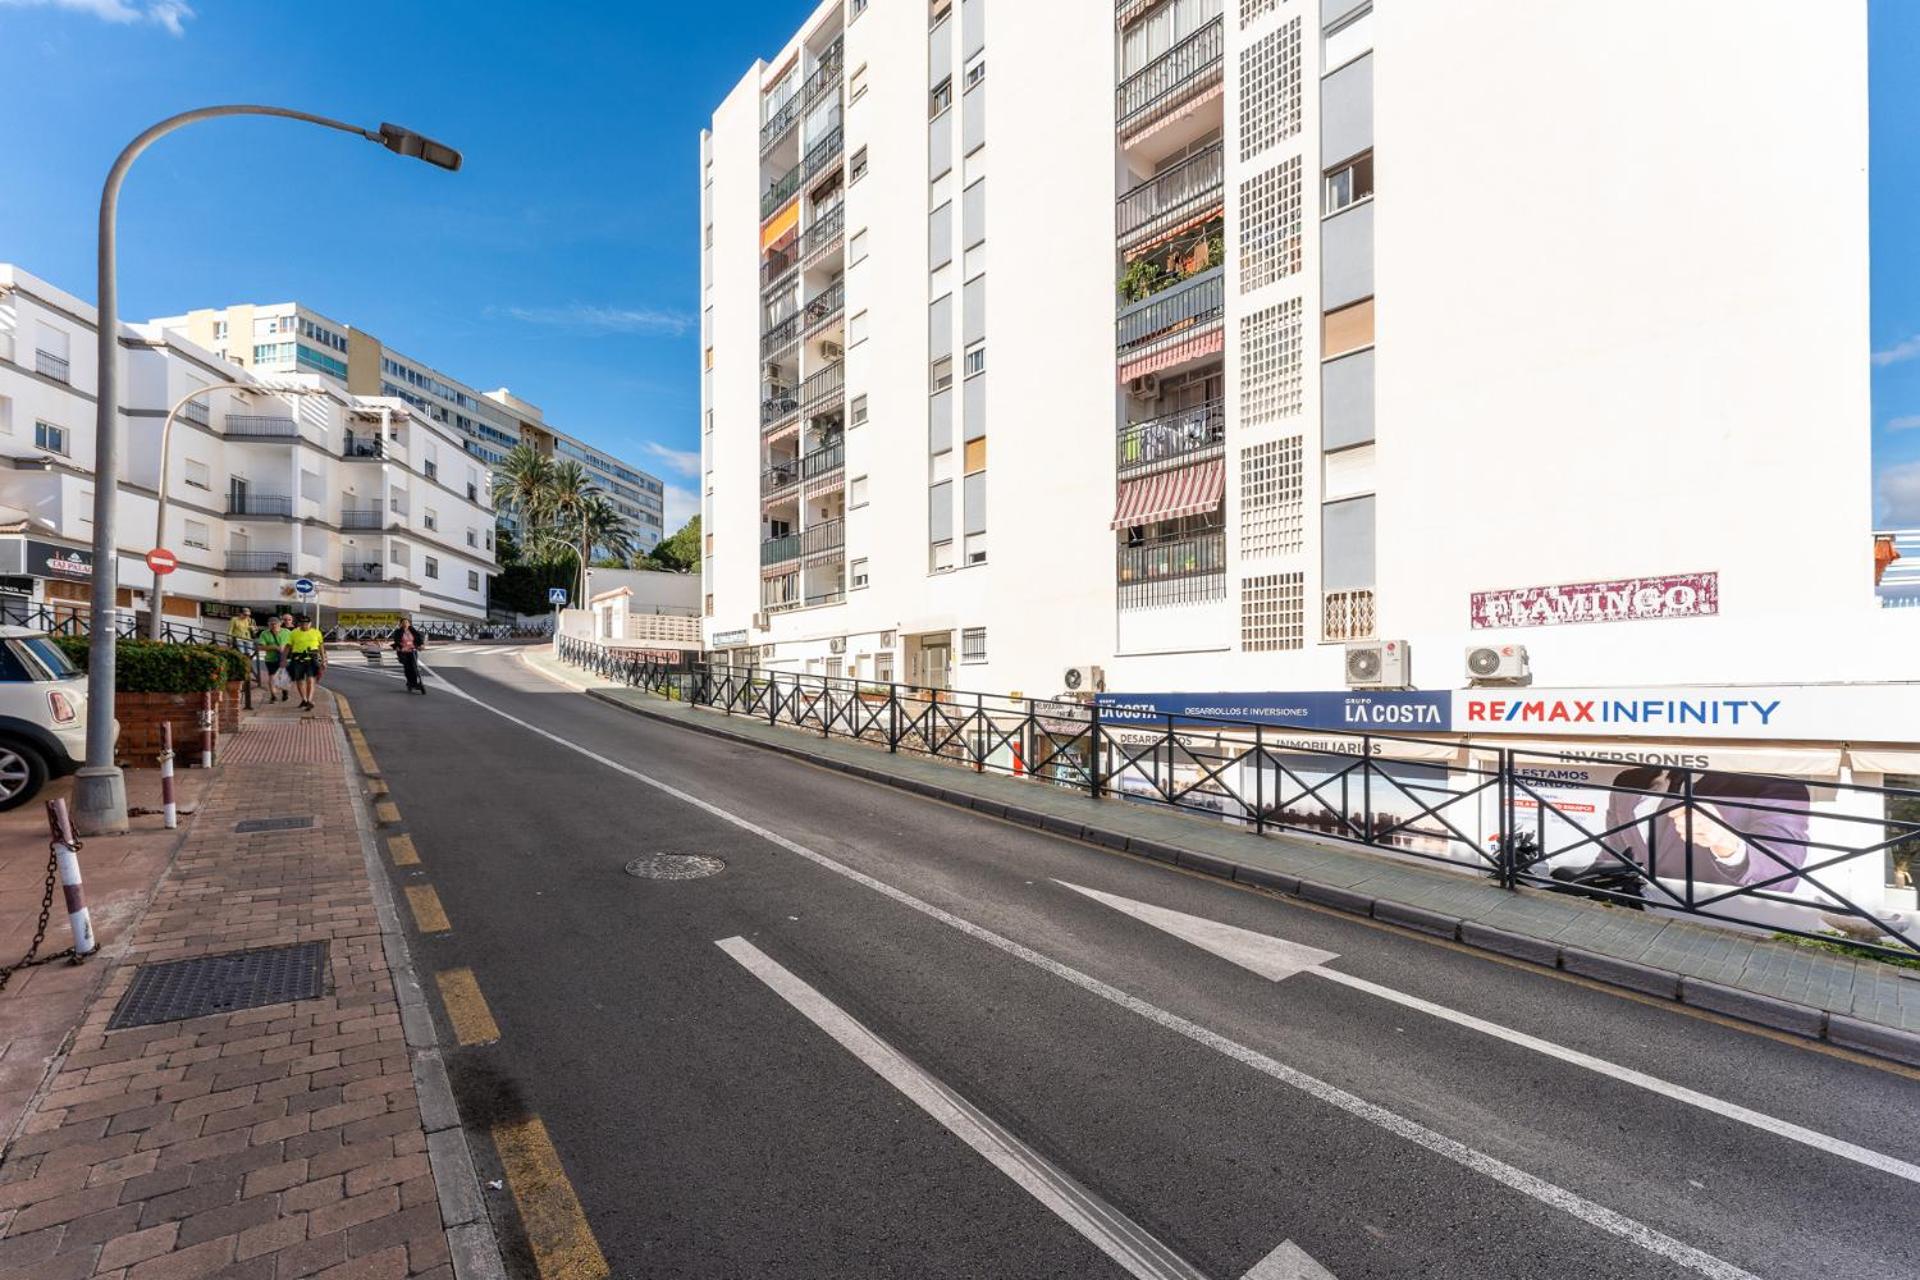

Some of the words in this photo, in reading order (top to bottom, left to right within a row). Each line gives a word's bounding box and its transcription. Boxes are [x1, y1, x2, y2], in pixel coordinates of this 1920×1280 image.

[1484, 585, 1698, 627] FLAMINGO
[1099, 704, 1114, 718] LA
[1115, 704, 1158, 719] COSTA
[1184, 707, 1241, 716] DESARROLLOS
[1243, 707, 1249, 716] E
[1250, 707, 1308, 717] INVERSIONES
[1345, 705, 1368, 722] LA
[1372, 705, 1441, 723] COSTA
[1468, 701, 1595, 723] RE/MAX
[1603, 701, 1781, 725] INFINITY
[1560, 750, 1709, 769] INVERSIONES
[1522, 768, 1590, 780] ESTAMOS
